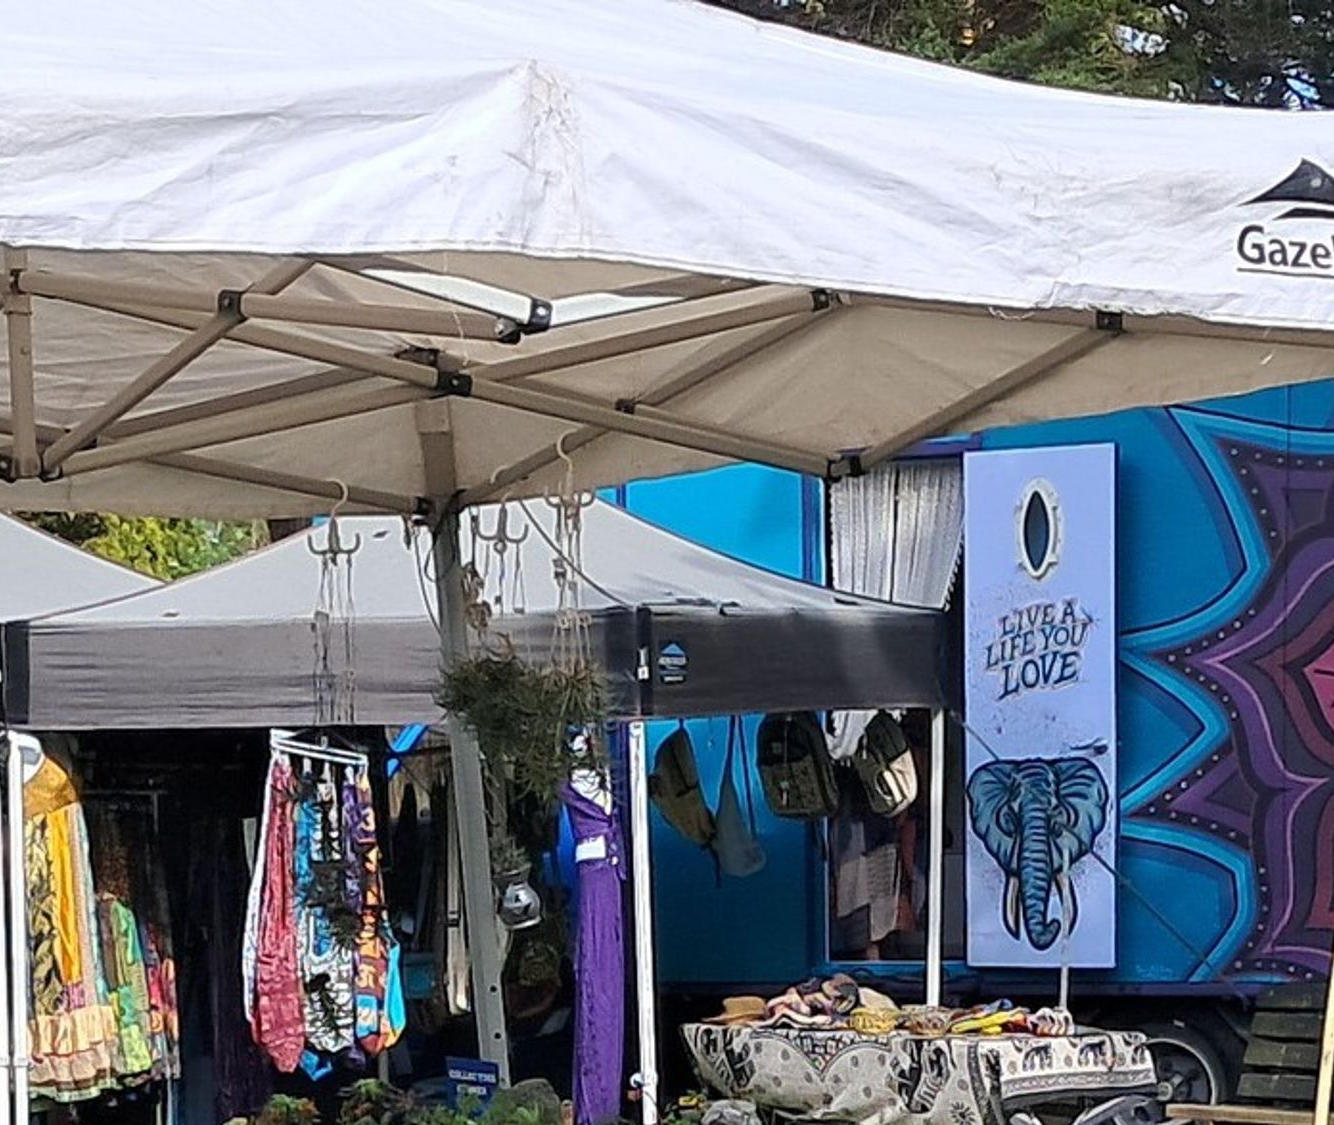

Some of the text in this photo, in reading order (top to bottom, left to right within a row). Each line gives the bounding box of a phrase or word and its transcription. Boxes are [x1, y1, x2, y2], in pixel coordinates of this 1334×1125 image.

[1000, 600, 1076, 638] LIVE A
[986, 622, 1088, 669] LIFE YOU
[998, 650, 1081, 701] LOVE
